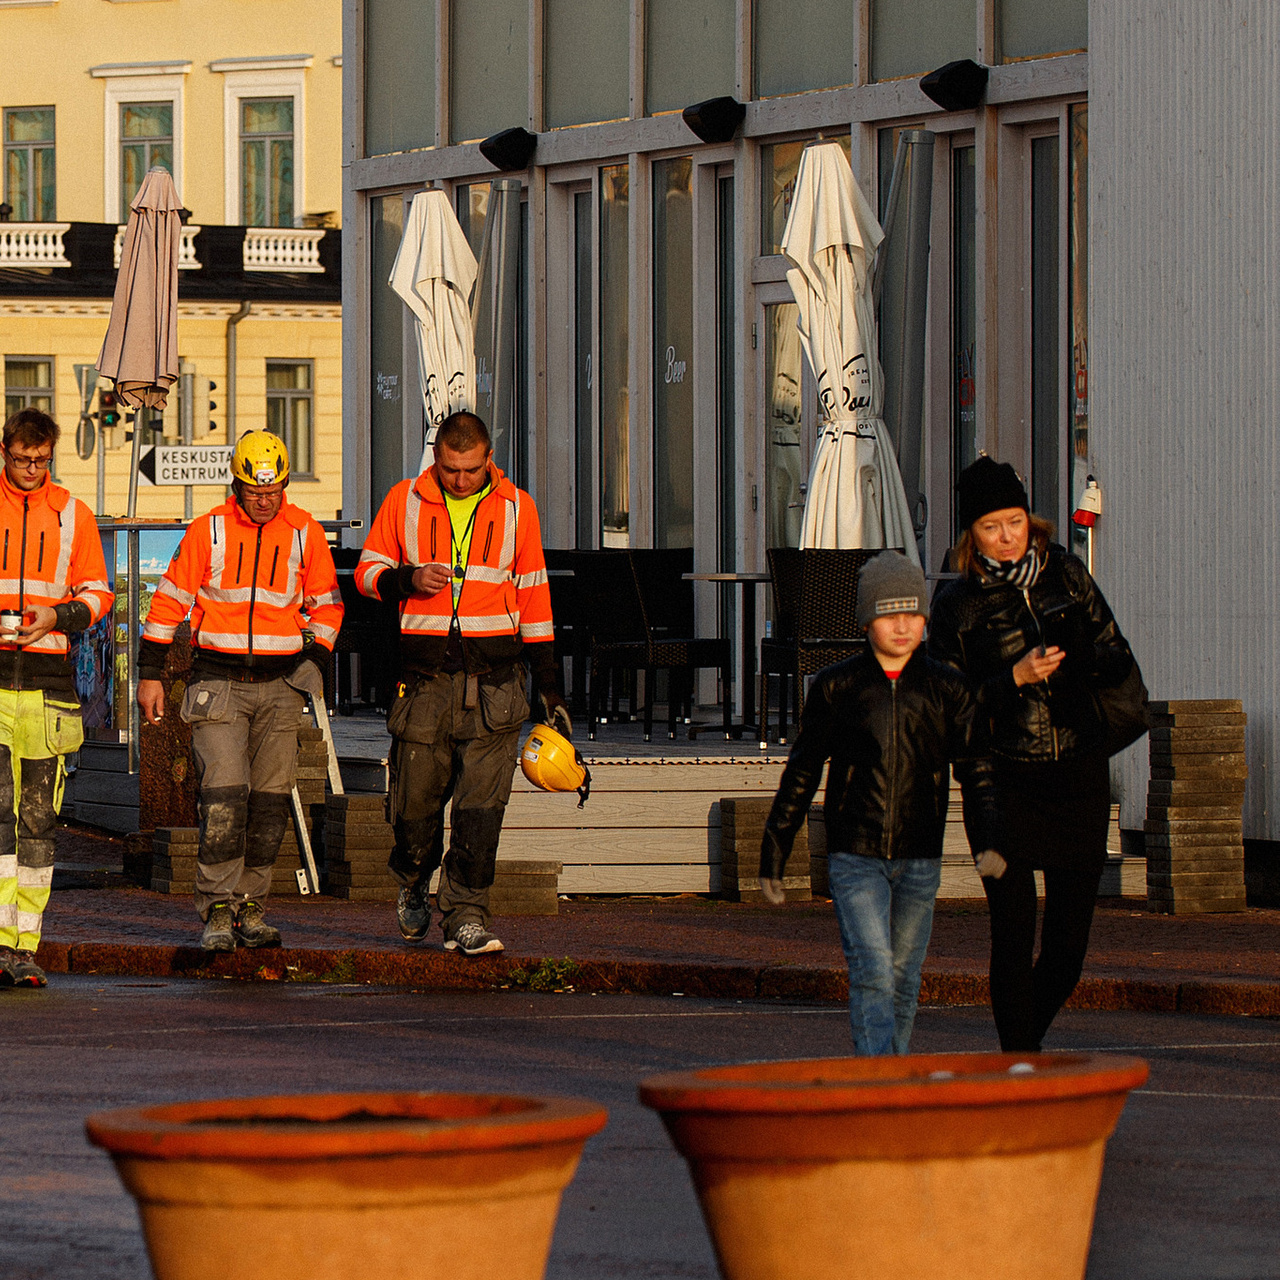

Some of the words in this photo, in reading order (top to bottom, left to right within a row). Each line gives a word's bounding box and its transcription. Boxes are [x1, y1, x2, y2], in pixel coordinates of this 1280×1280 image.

[665, 346, 685, 383] Beer
[162, 451, 231, 463] KESKUSTA
[162, 468, 228, 480] CENTRUM
